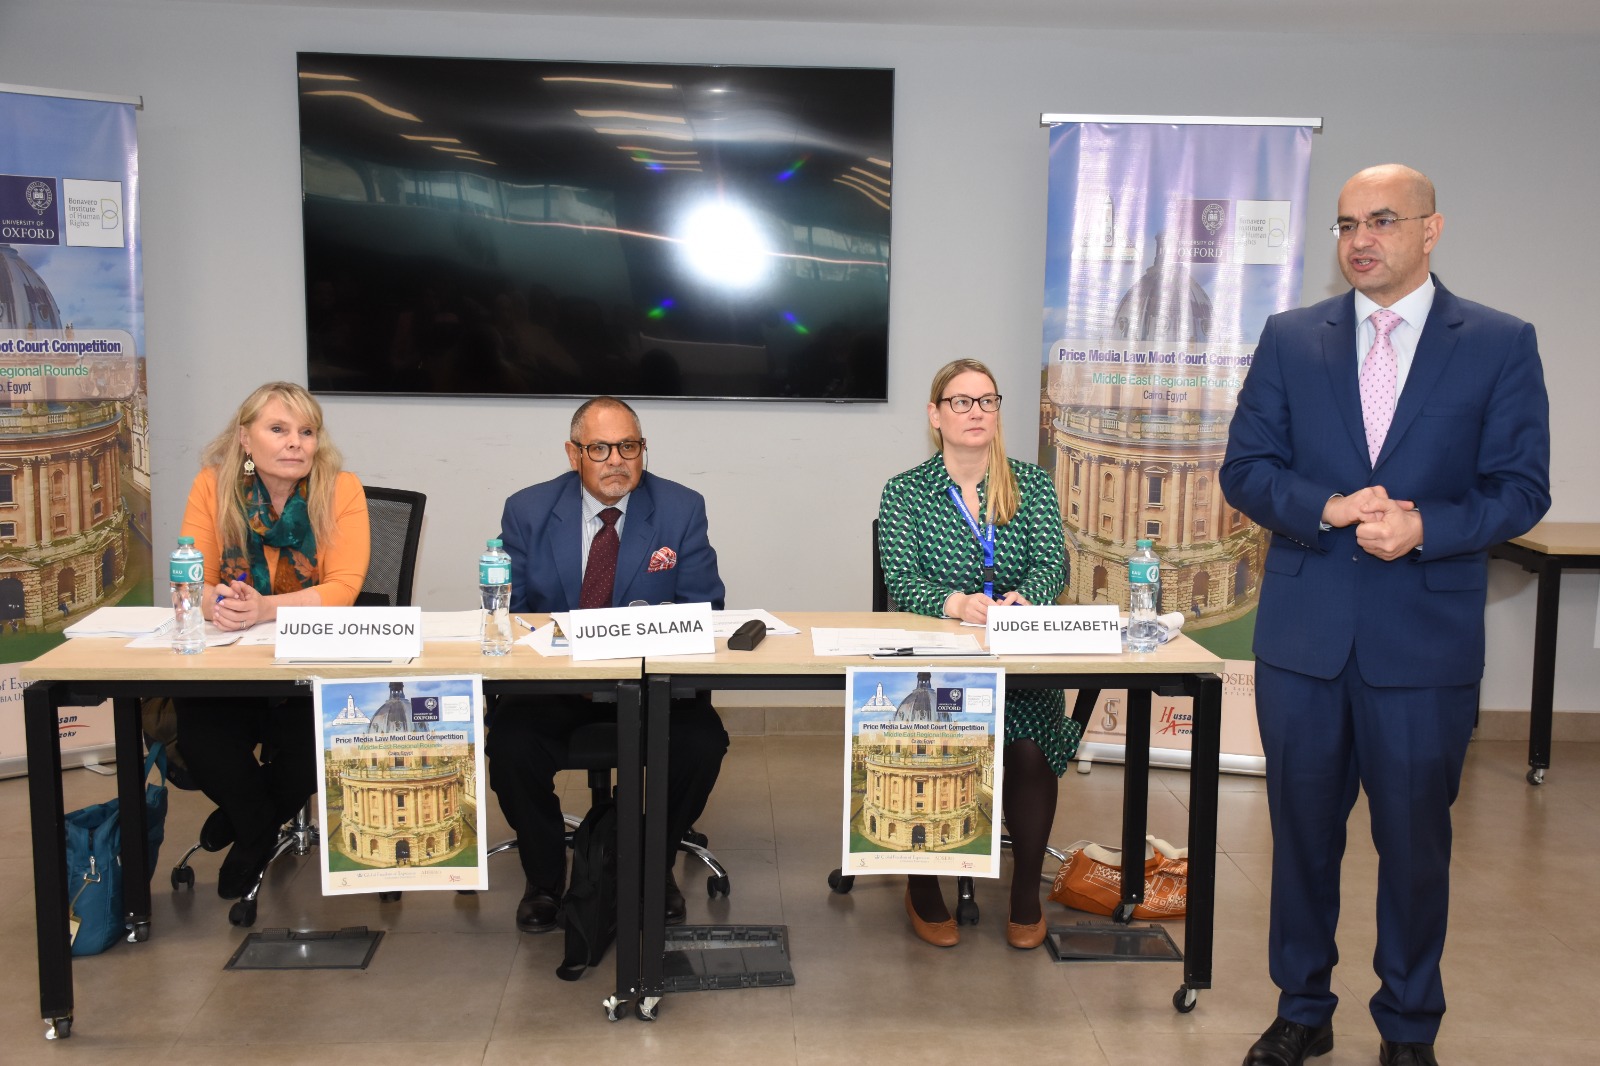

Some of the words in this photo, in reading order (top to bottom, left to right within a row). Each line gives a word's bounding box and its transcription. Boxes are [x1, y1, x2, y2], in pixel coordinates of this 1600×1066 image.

[68, 197, 98, 206] Bonavero
[68, 204, 96, 213] Institute
[77, 212, 100, 220] Human
[69, 219, 90, 228] Rights
[2, 227, 55, 239] OXFORD
[16, 340, 49, 353] Court
[52, 340, 121, 356] Competition
[1059, 348, 1086, 361] Price
[1089, 349, 1120, 362] Media
[1124, 350, 1146, 363] Law
[1148, 351, 1176, 364] Moot
[1177, 352, 1207, 365] Court
[44, 364, 89, 377] Rounds
[1092, 372, 1127, 385] Middle
[1129, 374, 1152, 386] East
[1153, 374, 1198, 388] Regional
[1200, 376, 1241, 388] Rounds
[7, 381, 32, 395] Egypt
[1166, 390, 1188, 403] Egypt
[280, 623, 334, 635] JUDGE
[338, 623, 415, 635] JOHNSON
[576, 624, 631, 639] JUDGE
[636, 620, 703, 635] SALAMA
[993, 621, 1039, 632] JUDGE
[1043, 620, 1119, 631] ELIZABETH
[353, 735, 374, 743] Media
[407, 733, 425, 741] Court
[426, 733, 464, 741] Competition
